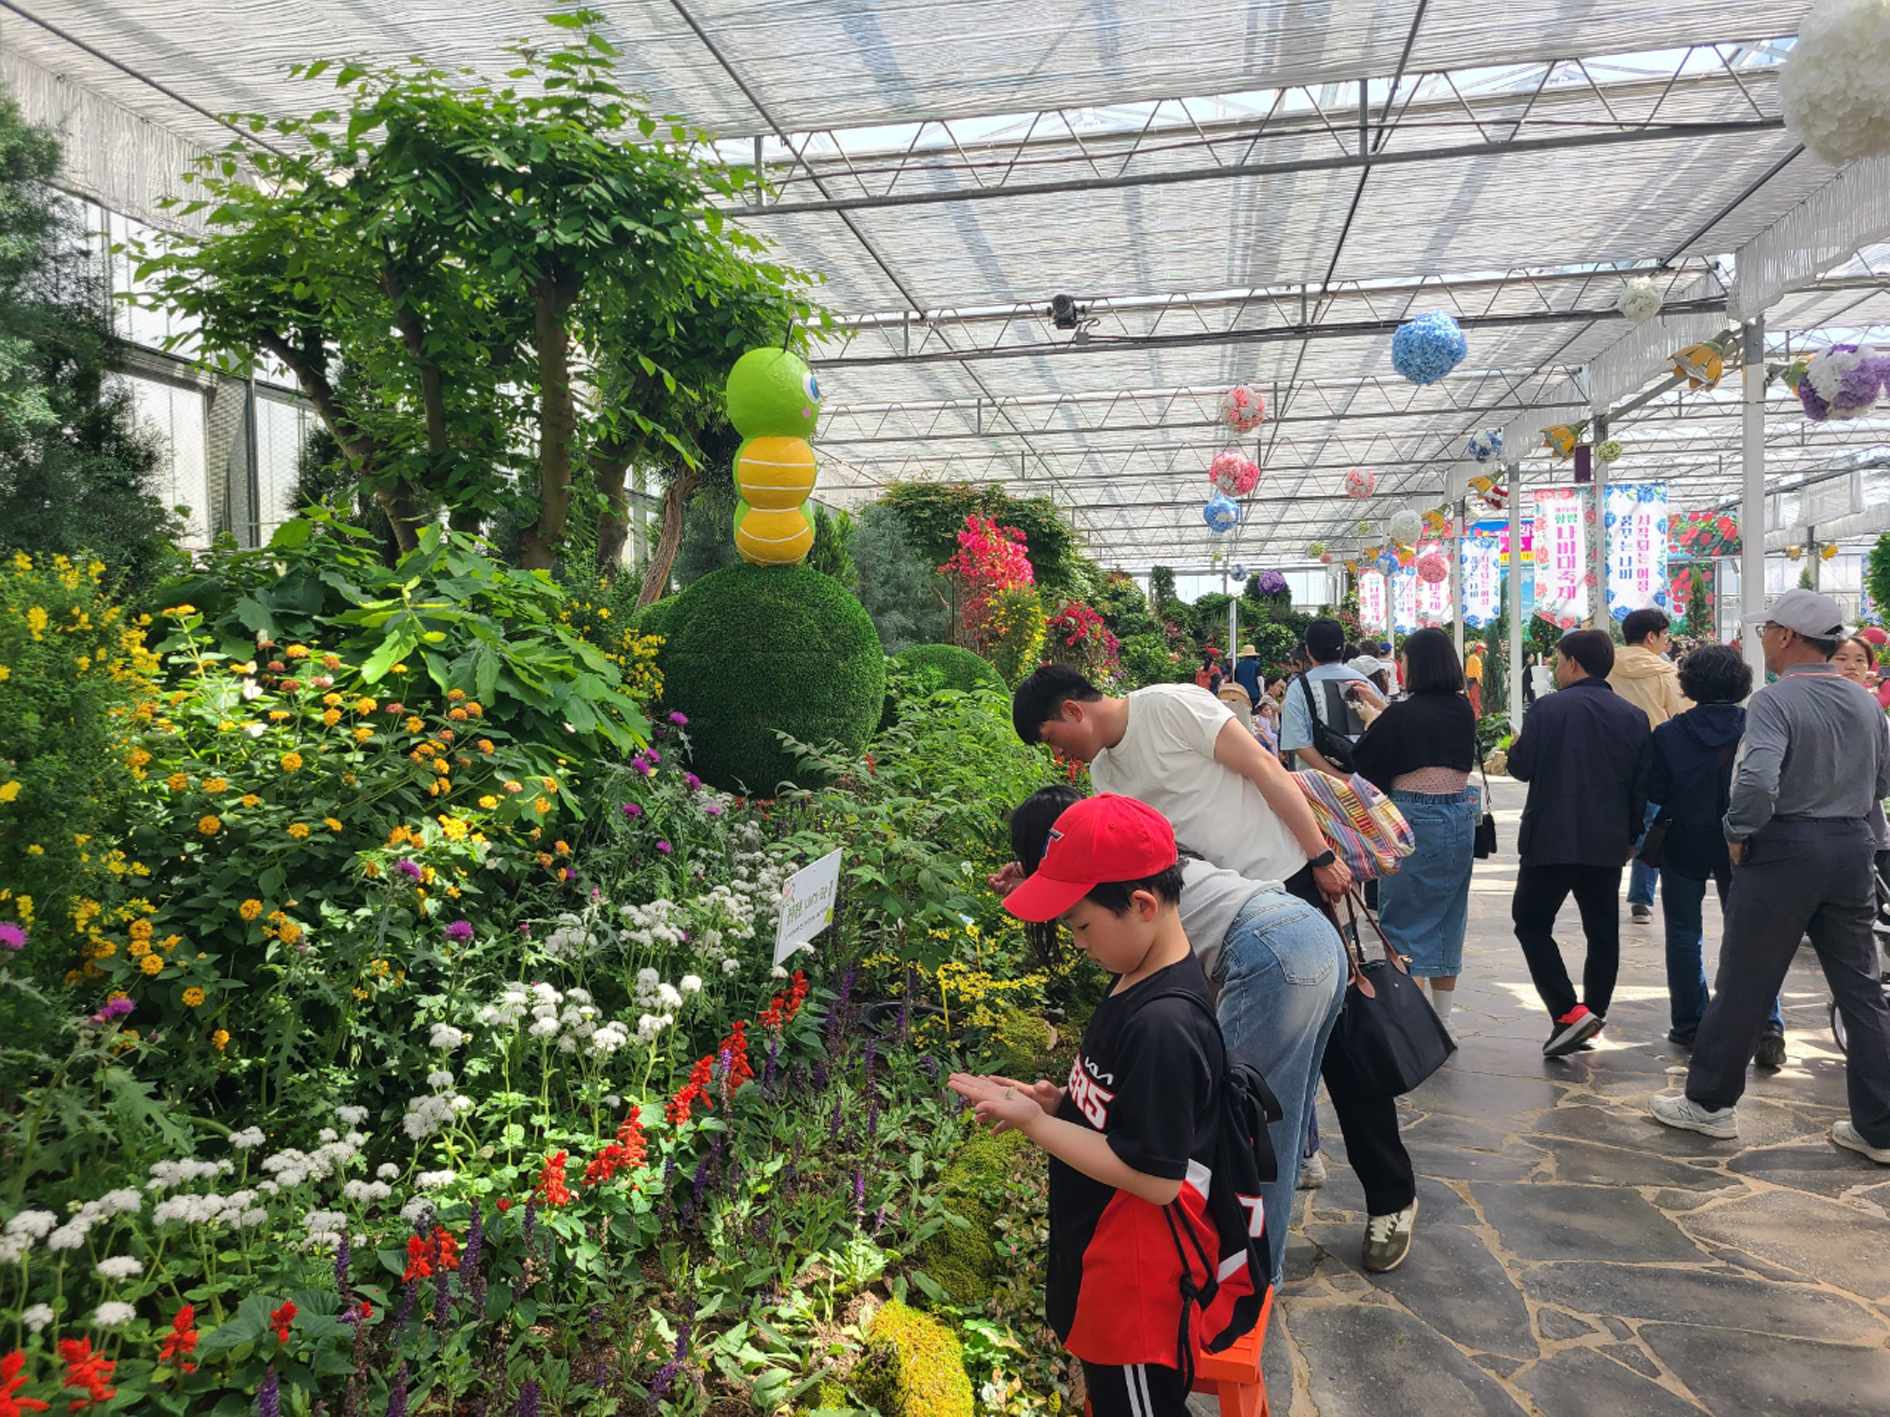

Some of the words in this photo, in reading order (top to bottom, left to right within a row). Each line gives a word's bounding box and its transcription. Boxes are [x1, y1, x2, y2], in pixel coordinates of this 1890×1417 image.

[1620, 515, 1633, 552] 꿈꾸는
[1636, 514, 1650, 564] 시작되는
[1556, 525, 1577, 600] 나비대축제
[1619, 556, 1633, 579] 나비
[1636, 567, 1649, 592] 여정
